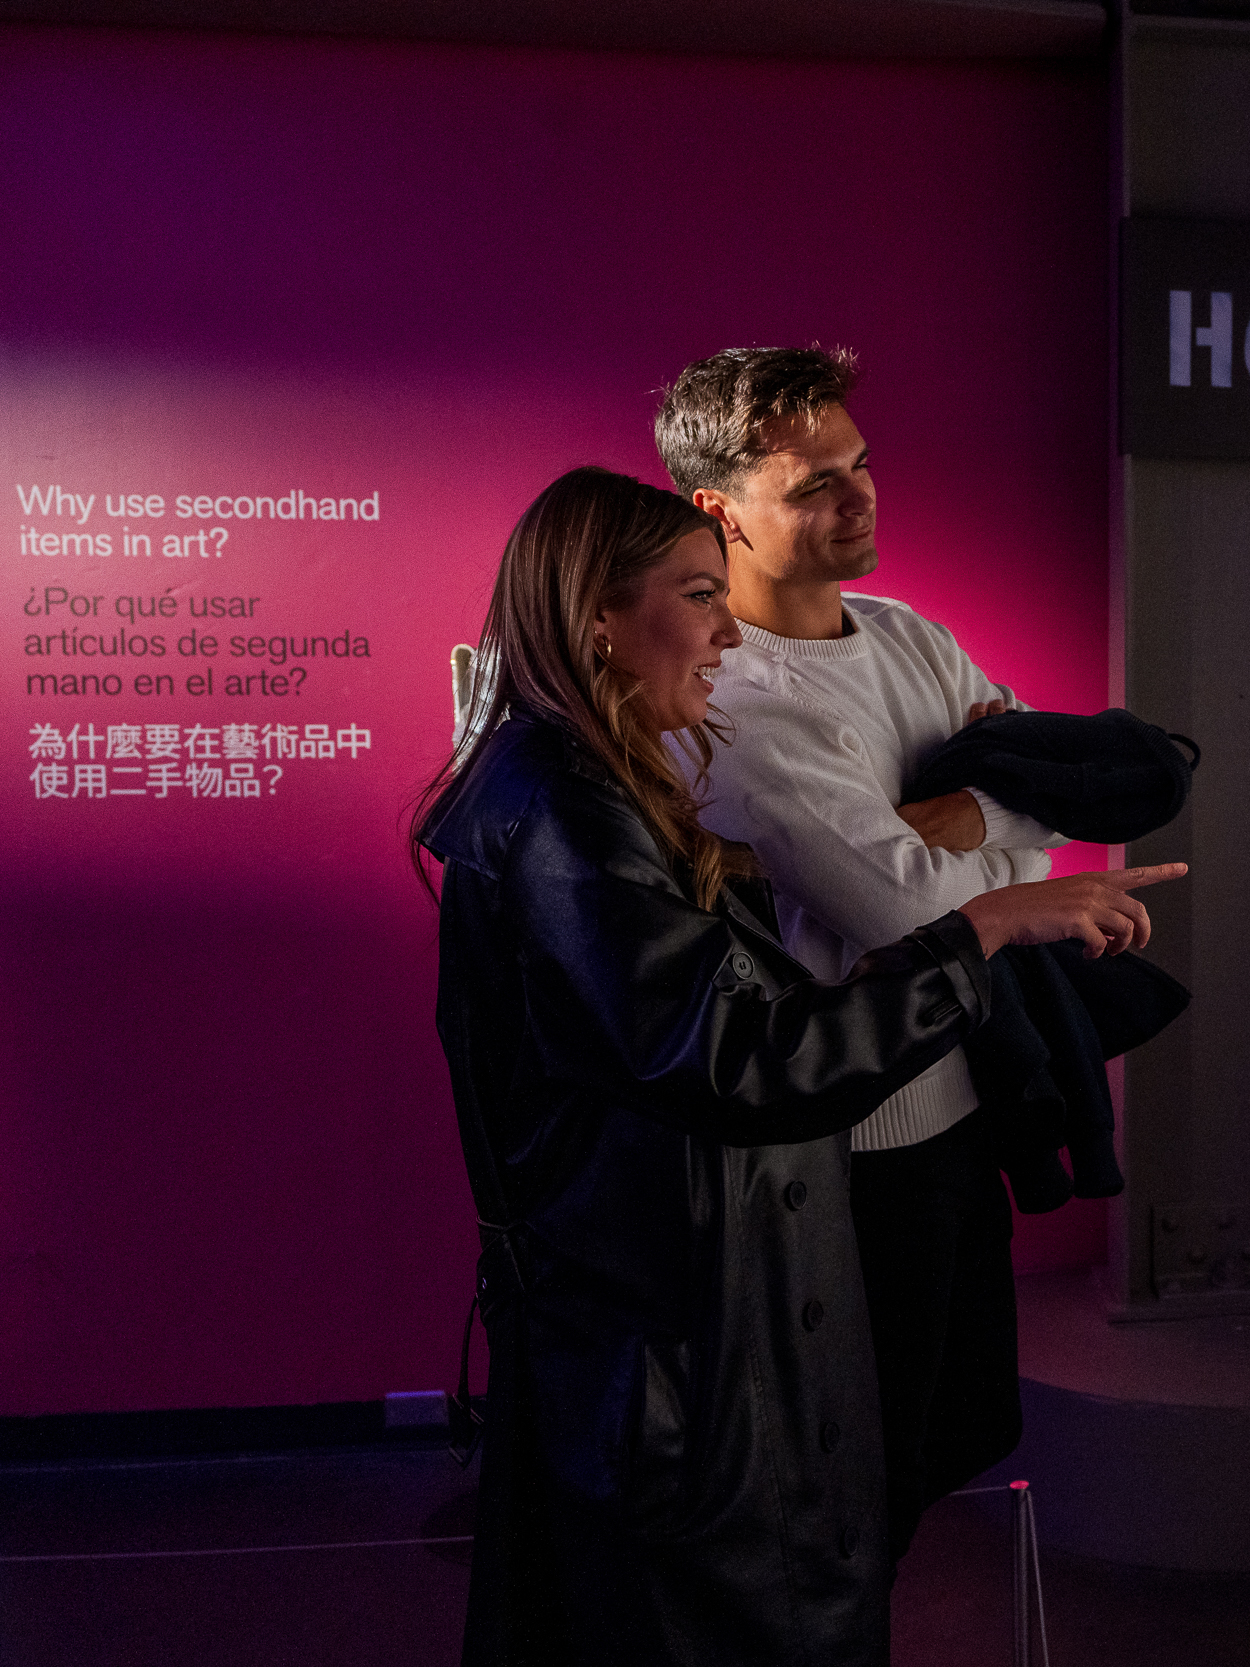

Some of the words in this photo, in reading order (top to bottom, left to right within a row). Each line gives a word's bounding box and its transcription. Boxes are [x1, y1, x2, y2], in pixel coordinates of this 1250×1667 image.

[16, 484, 95, 524] Why
[106, 494, 165, 519] use
[176, 489, 380, 521] secondhand
[21, 525, 113, 556] items
[124, 527, 151, 556] in
[162, 527, 229, 557] art?
[23, 587, 105, 617] ¿Por
[114, 588, 178, 624] qué
[189, 596, 262, 618] usar
[24, 627, 166, 657] artículos
[177, 629, 219, 657] de
[229, 630, 372, 665] segunda
[26, 674, 123, 696] mano
[134, 674, 174, 696] en
[186, 667, 213, 696] el
[224, 667, 308, 696] arte?
[29, 723, 371, 759] 為什麼要在藝術品中
